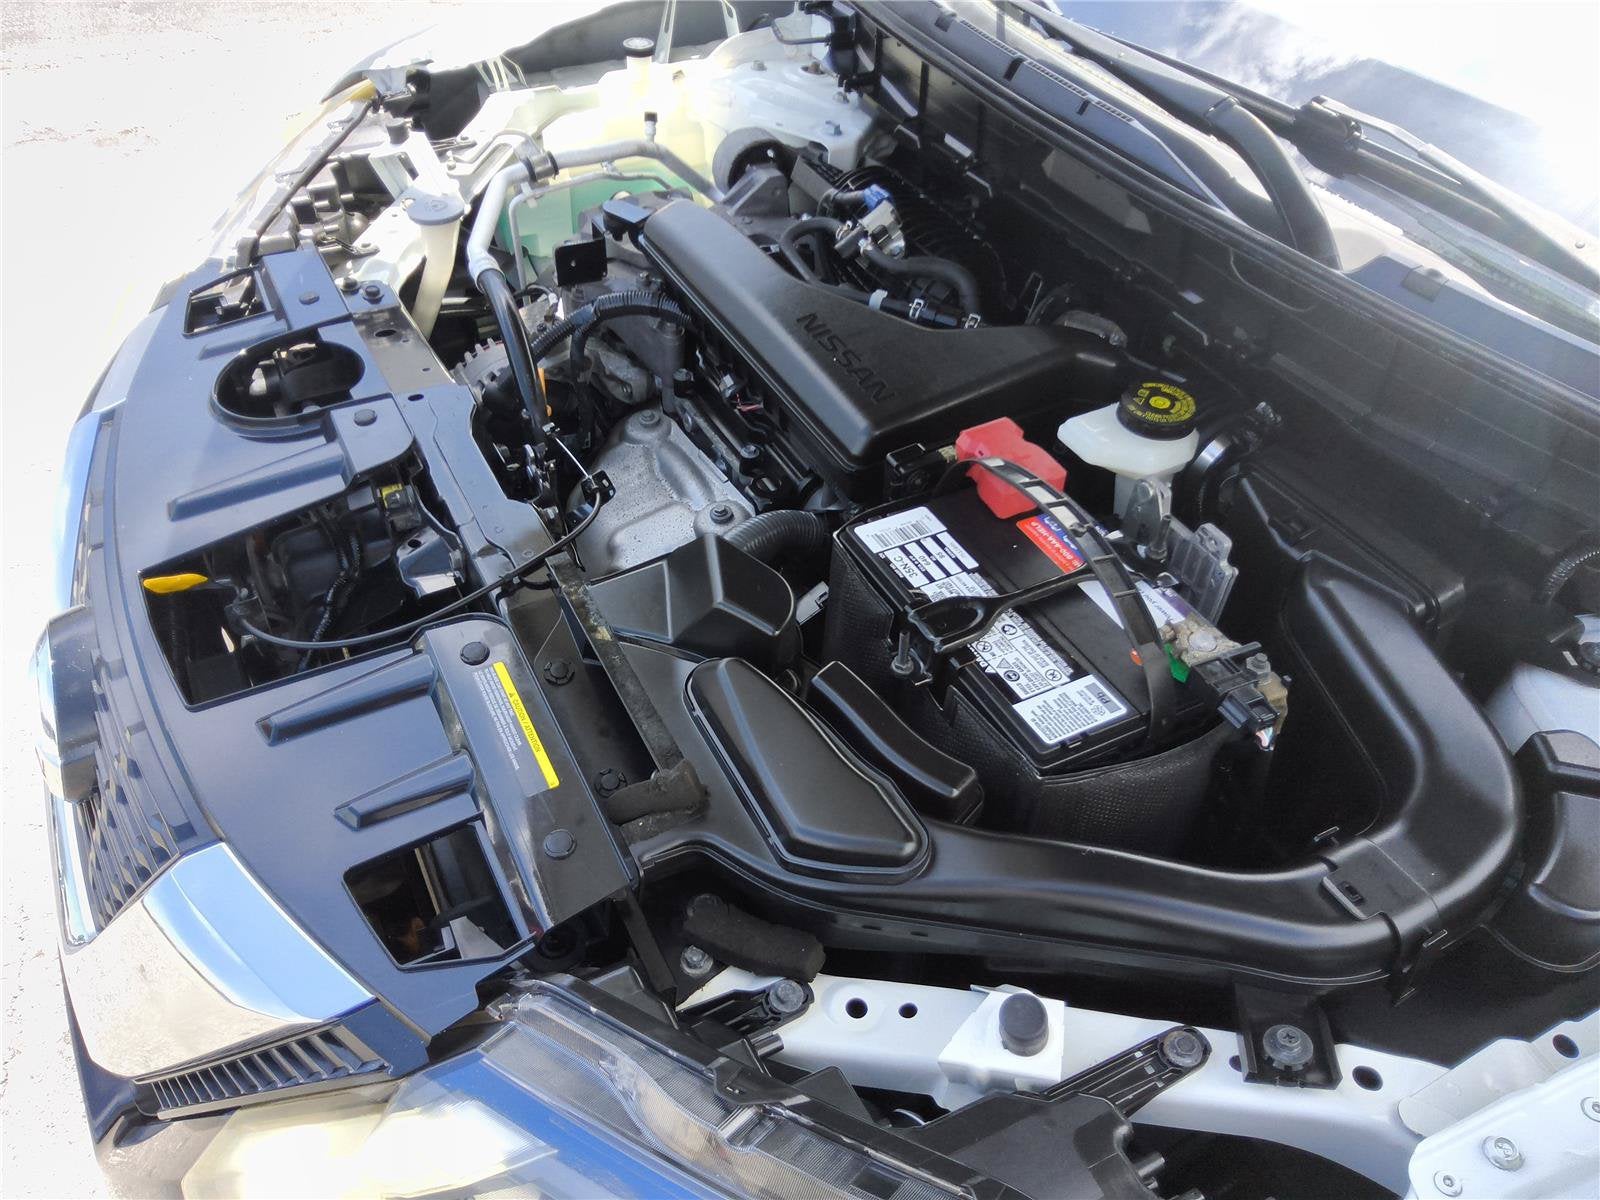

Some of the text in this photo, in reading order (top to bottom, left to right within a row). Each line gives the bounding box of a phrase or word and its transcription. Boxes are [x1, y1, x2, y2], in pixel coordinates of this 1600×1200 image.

[796, 312, 895, 403] NISSAN
[892, 554, 917, 577] 35N-C
[1096, 691, 1110, 704] Pb
[512, 699, 525, 721] CAUTION
[524, 725, 541, 752] ATTENTION
